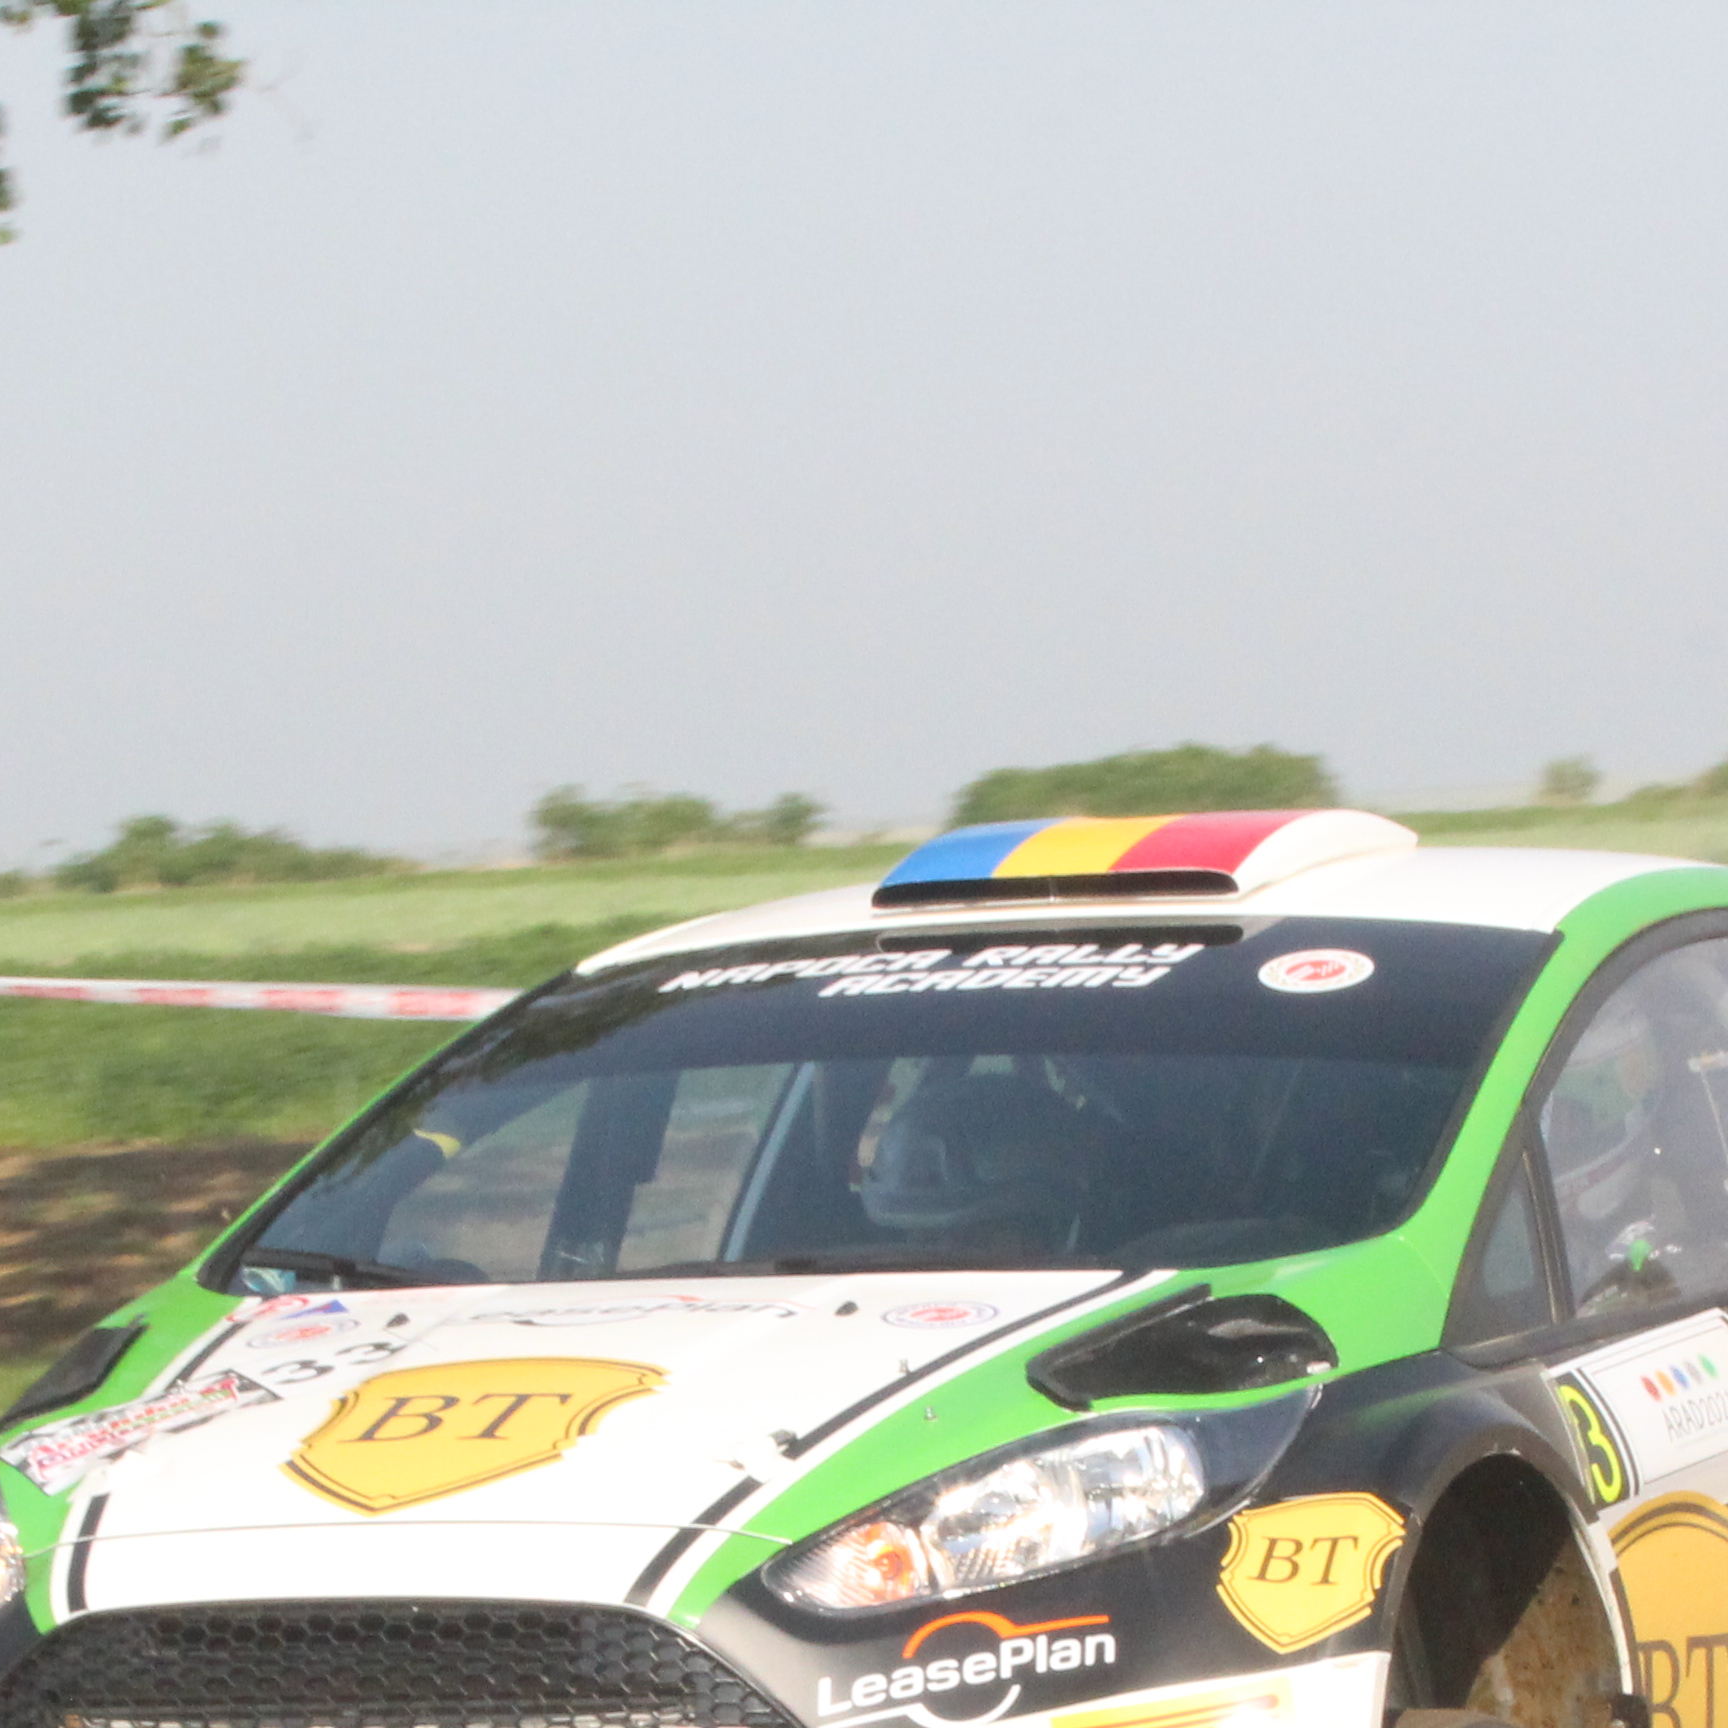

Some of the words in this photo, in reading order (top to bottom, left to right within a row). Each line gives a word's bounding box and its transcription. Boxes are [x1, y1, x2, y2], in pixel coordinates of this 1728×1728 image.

[658, 948, 953, 993] NAPOCA
[962, 943, 1205, 967] RALLY
[818, 964, 1172, 998] ACADEMY
[337, 1392, 574, 1444] BT
[1247, 1534, 1359, 1586] BT
[817, 1633, 1117, 1717] LeasePlan
